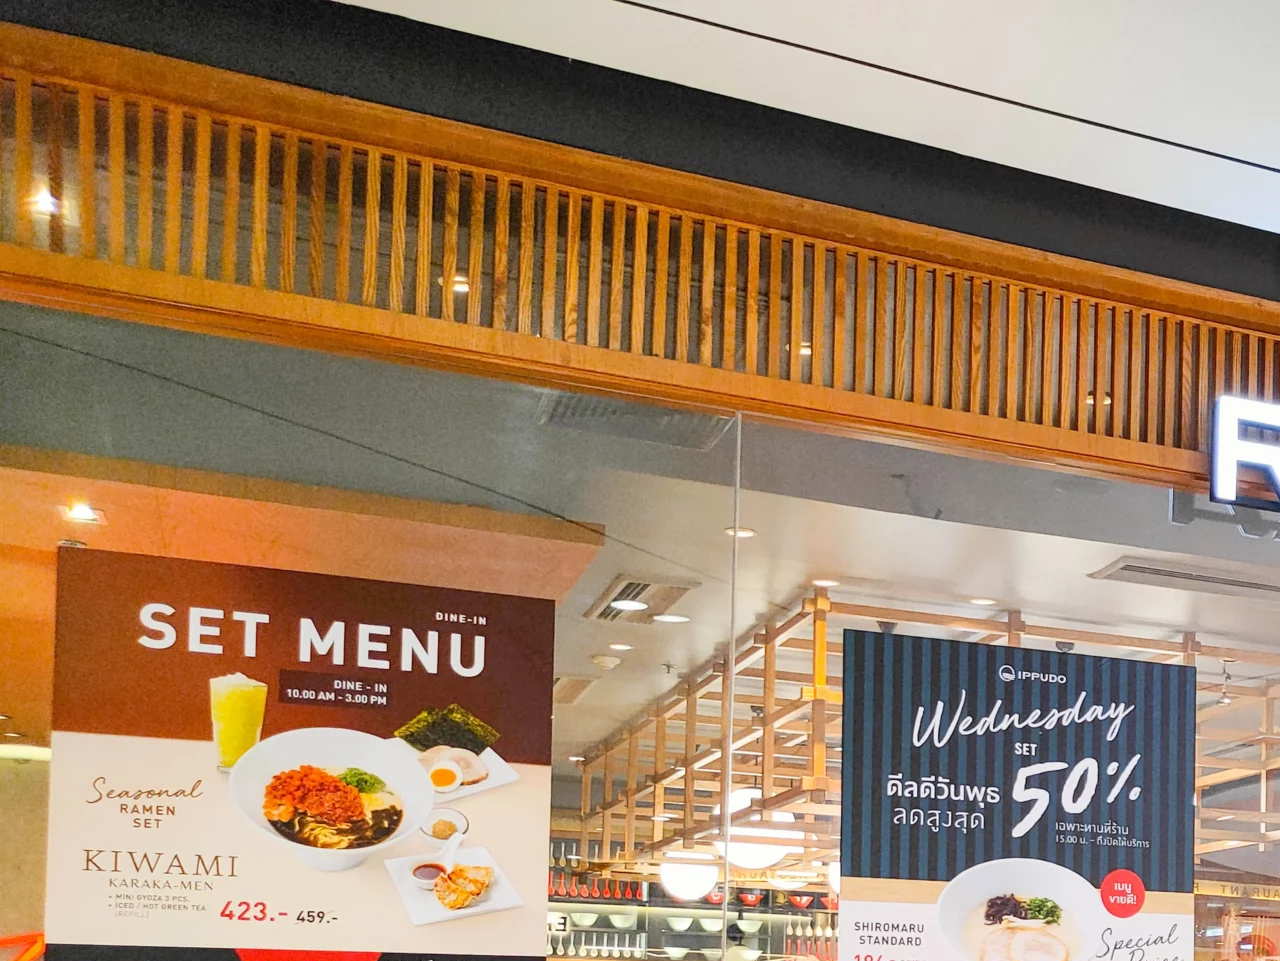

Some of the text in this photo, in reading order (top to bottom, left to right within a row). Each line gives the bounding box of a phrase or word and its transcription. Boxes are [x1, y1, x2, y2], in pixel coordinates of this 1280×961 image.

[435, 611, 487, 626] DINE-IN
[138, 602, 487, 678] SET MENU
[1017, 670, 1067, 684] IPPUDO
[333, 679, 388, 693] DINE IN
[286, 688, 387, 705] 10.00 AM 3.00 PM
[912, 689, 1135, 748] Wednesday
[1014, 742, 1038, 757] SET
[86, 776, 204, 804] Seasonal
[887, 773, 1001, 809] ดีลดีวันพุธ
[1011, 753, 1142, 838] 50%
[120, 803, 176, 816] RAMEN
[133, 818, 163, 829] SET
[893, 807, 985, 834] ลดสูงสุด
[1056, 835, 1077, 844] 15.00
[82, 849, 239, 877] KIWAMI
[109, 877, 214, 891] KARAKA-MEN
[220, 901, 338, 924] 423.- 459.-
[854, 921, 924, 934] SHIROMARU
[859, 935, 922, 947] STANDARD
[1095, 924, 1180, 959] Special
